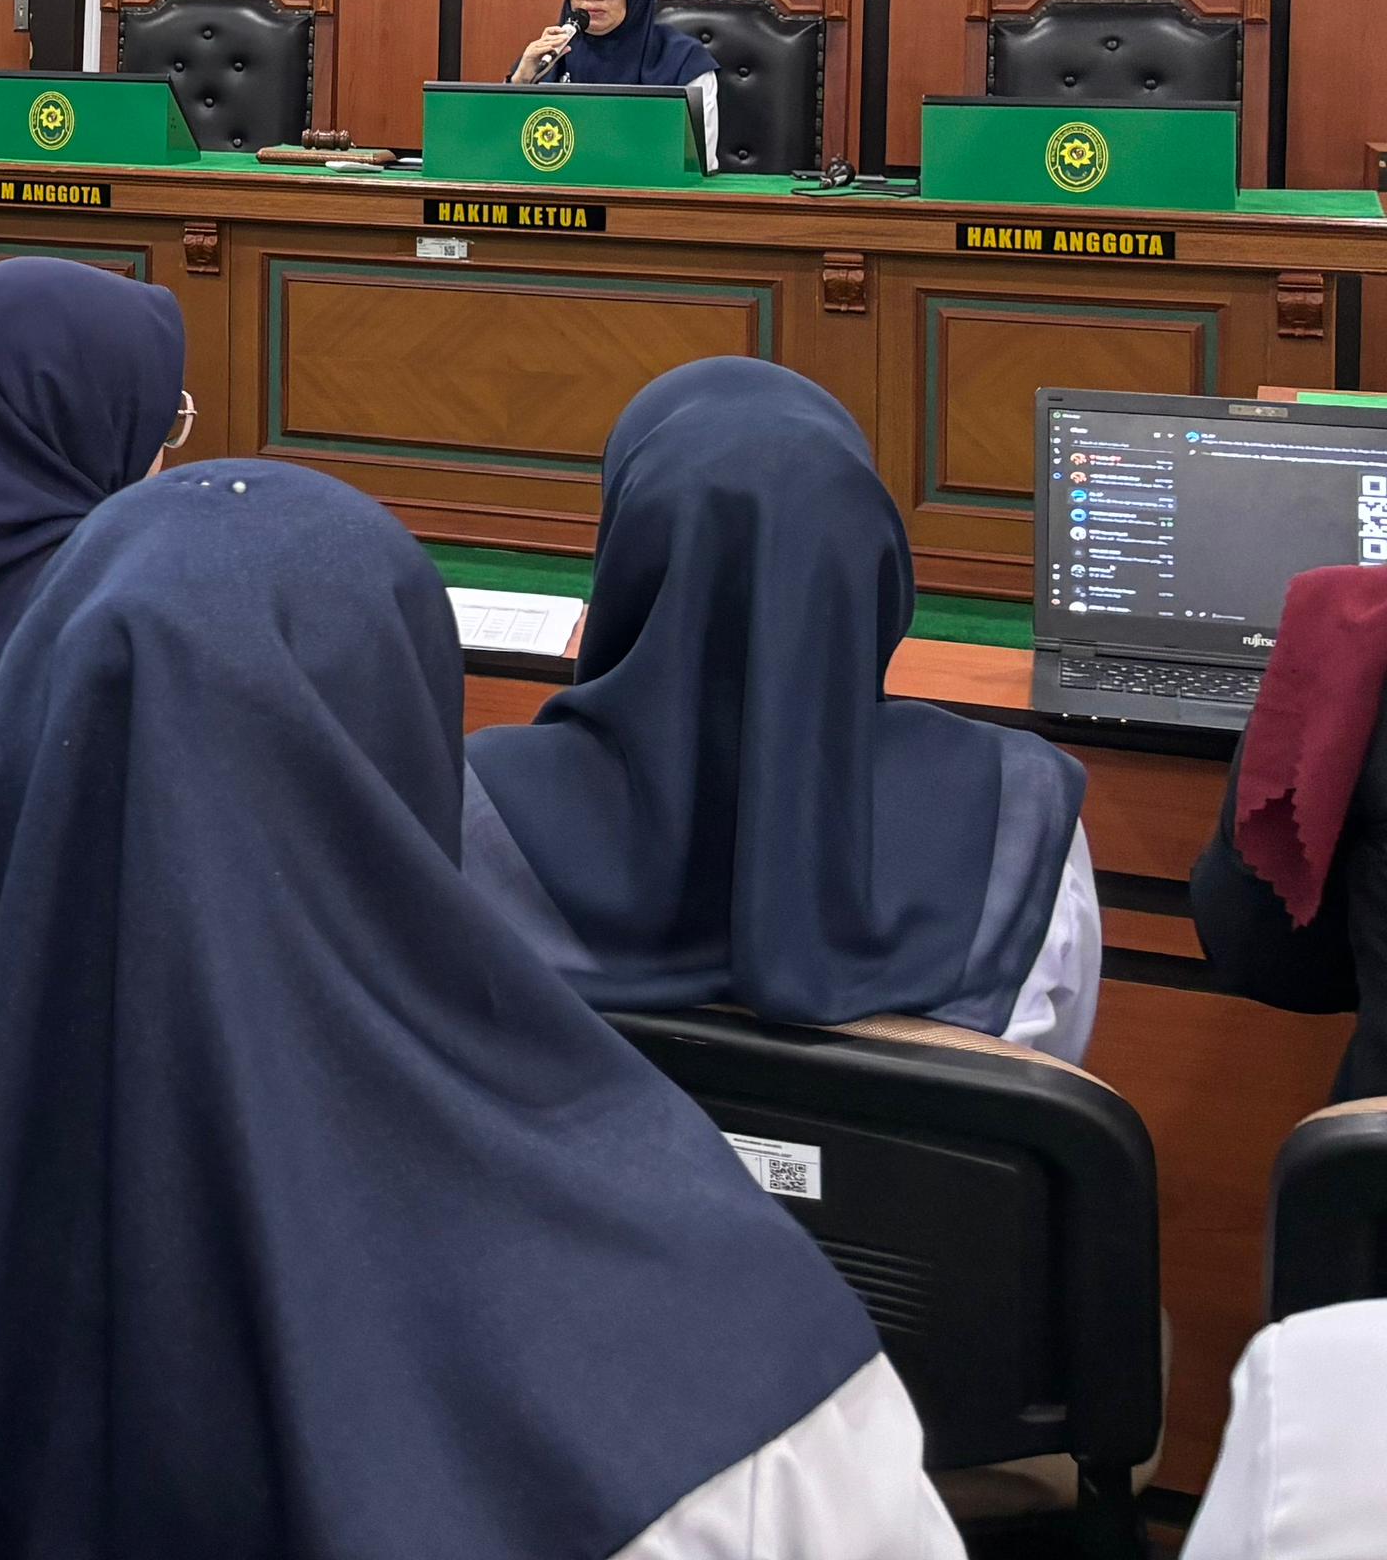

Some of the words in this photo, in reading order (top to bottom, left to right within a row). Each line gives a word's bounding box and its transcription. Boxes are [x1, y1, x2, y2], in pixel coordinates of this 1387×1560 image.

[22, 183, 101, 205] ANGGOTA
[438, 202, 508, 224] HAKIM
[519, 205, 588, 228] KETUA
[967, 226, 1042, 250] HAKIM
[1053, 230, 1164, 256] ANGGOTA
